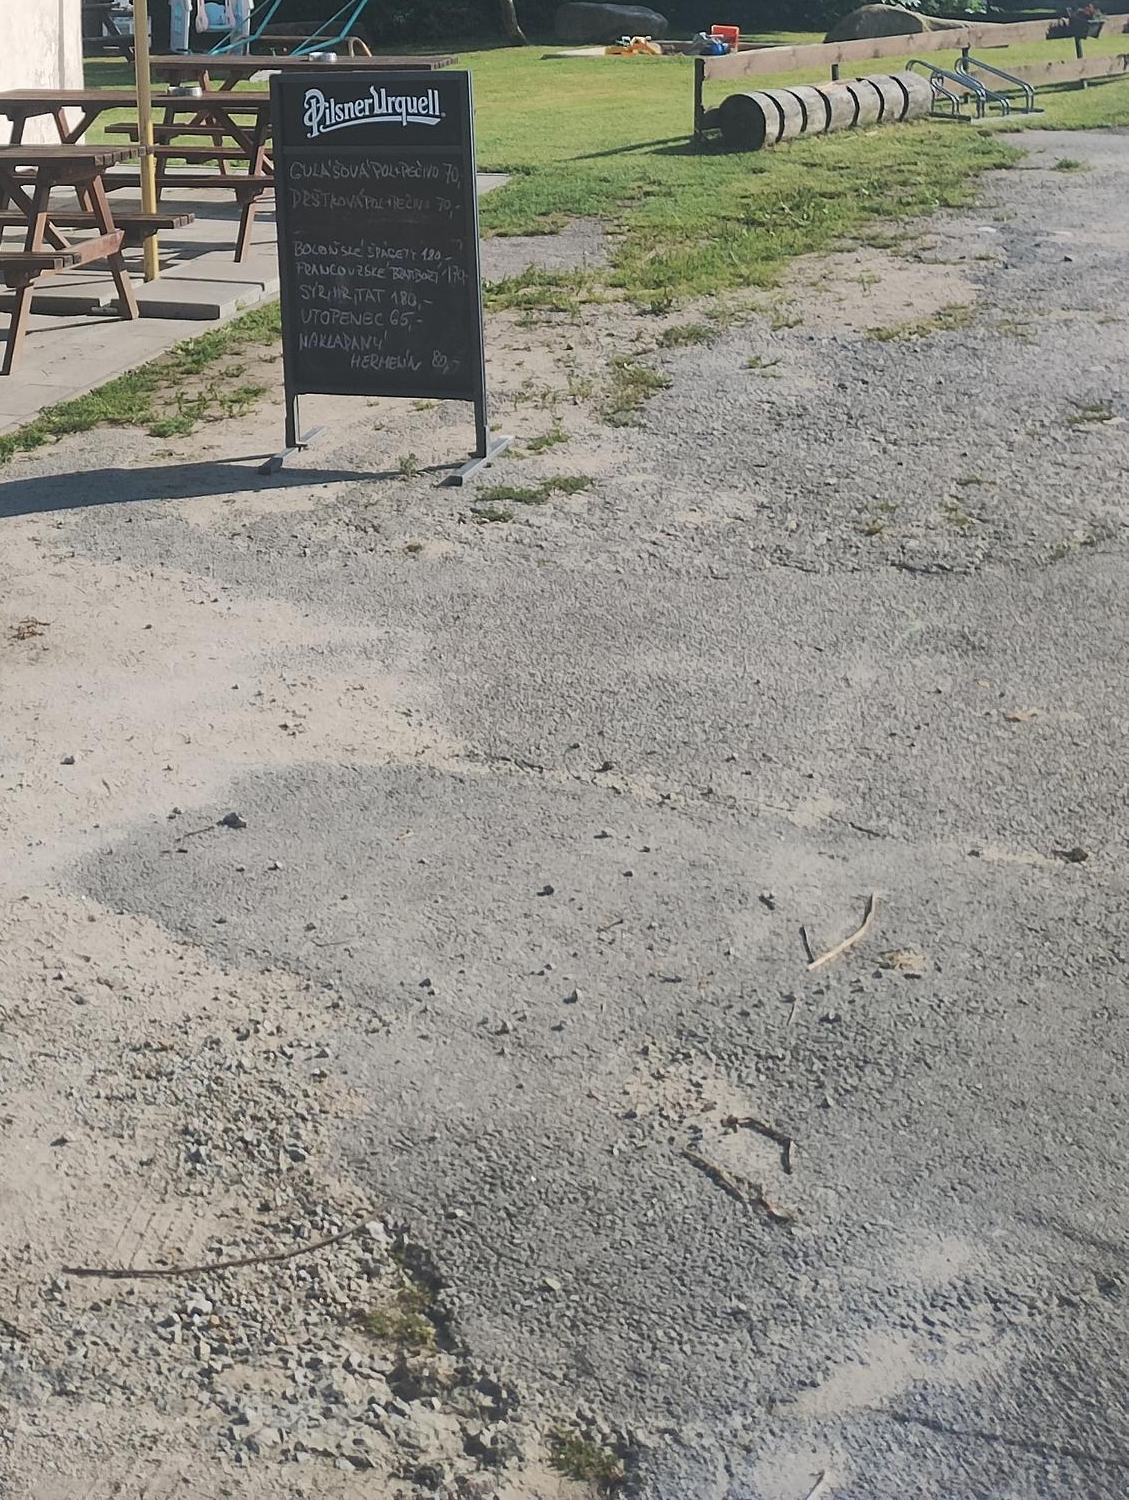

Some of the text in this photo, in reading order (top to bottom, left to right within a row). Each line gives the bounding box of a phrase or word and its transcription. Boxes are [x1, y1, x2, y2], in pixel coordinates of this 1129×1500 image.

[303, 86, 440, 139] Pilsner Urquell
[301, 308, 384, 326] UTOPENEC
